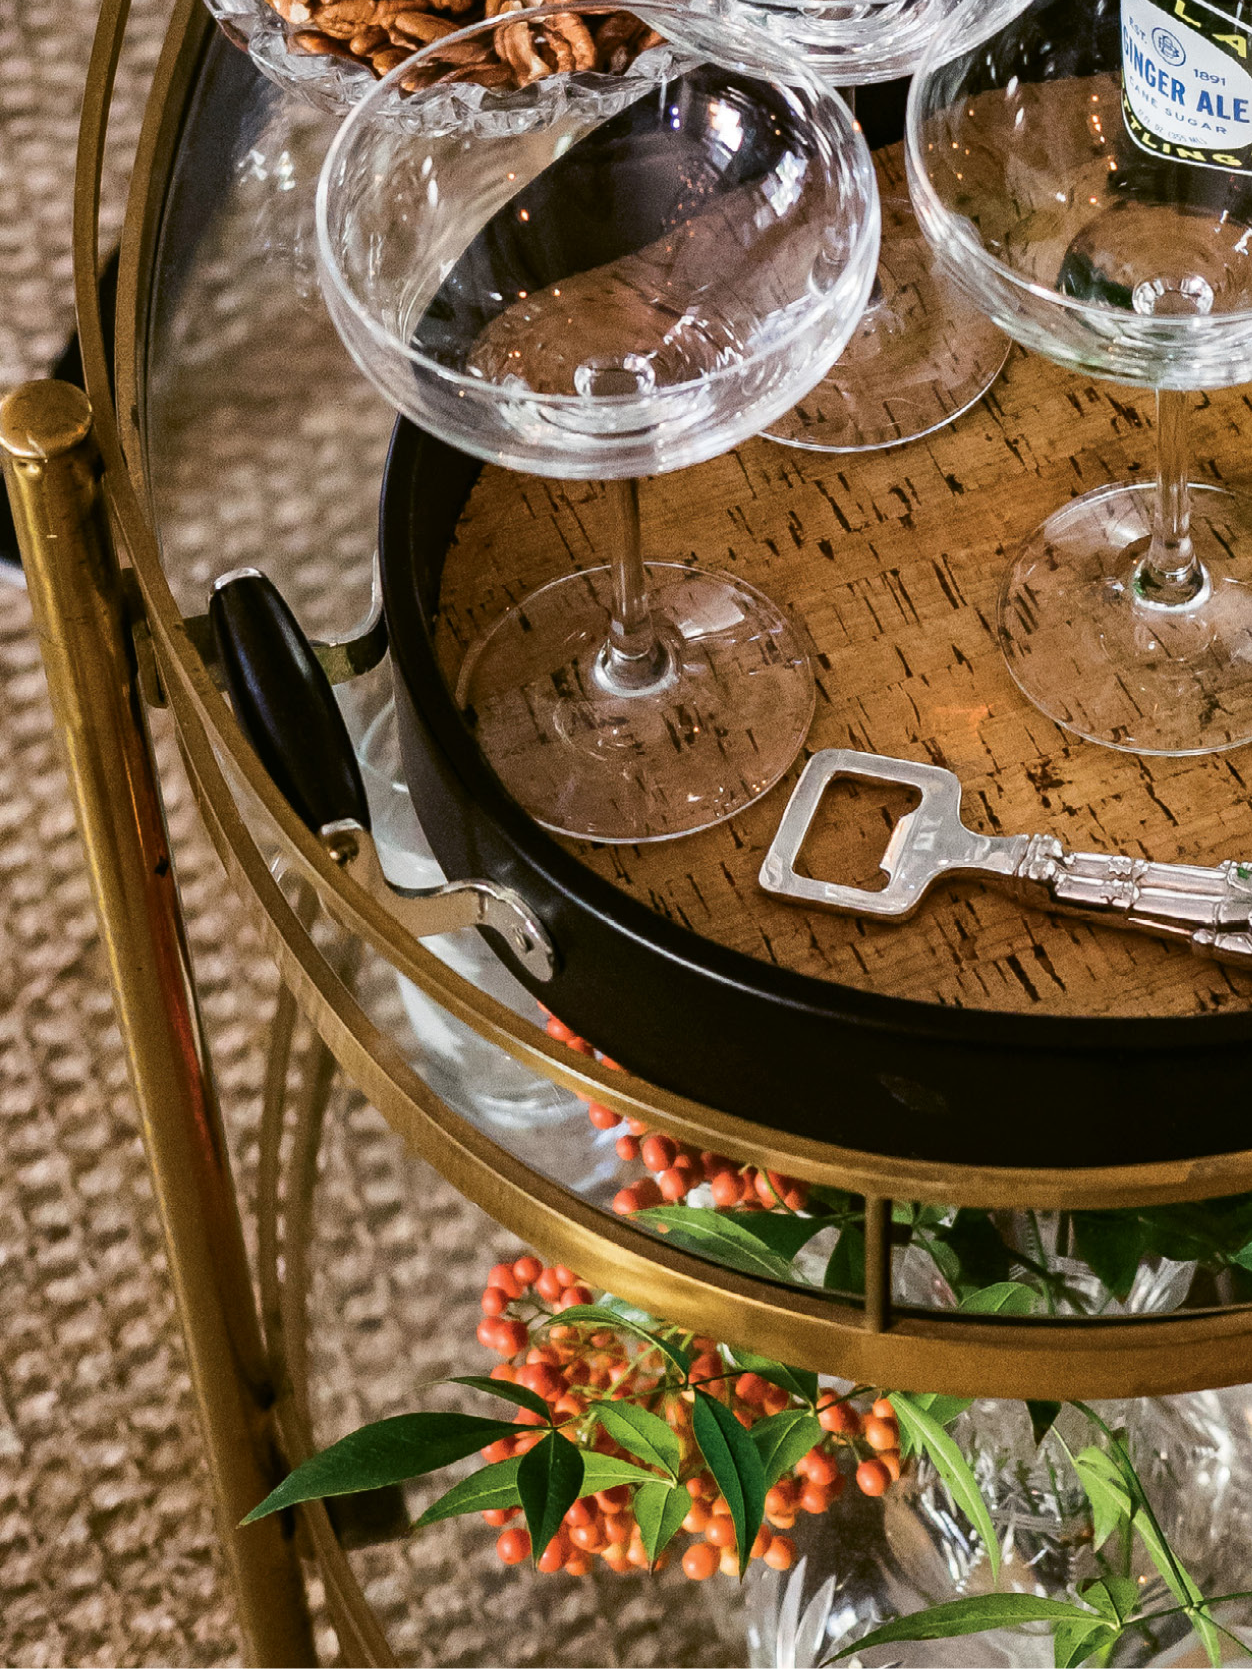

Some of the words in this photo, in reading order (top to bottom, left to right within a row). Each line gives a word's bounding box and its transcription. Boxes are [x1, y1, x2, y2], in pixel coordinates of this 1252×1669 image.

[1123, 25, 1186, 106] GINGER
[1196, 90, 1250, 123] ALE
[1129, 75, 1158, 109] CANE
[1165, 108, 1228, 135] SUGAR
[1193, 68, 1226, 86] 1891
[1121, 69, 1243, 166] TTLING
